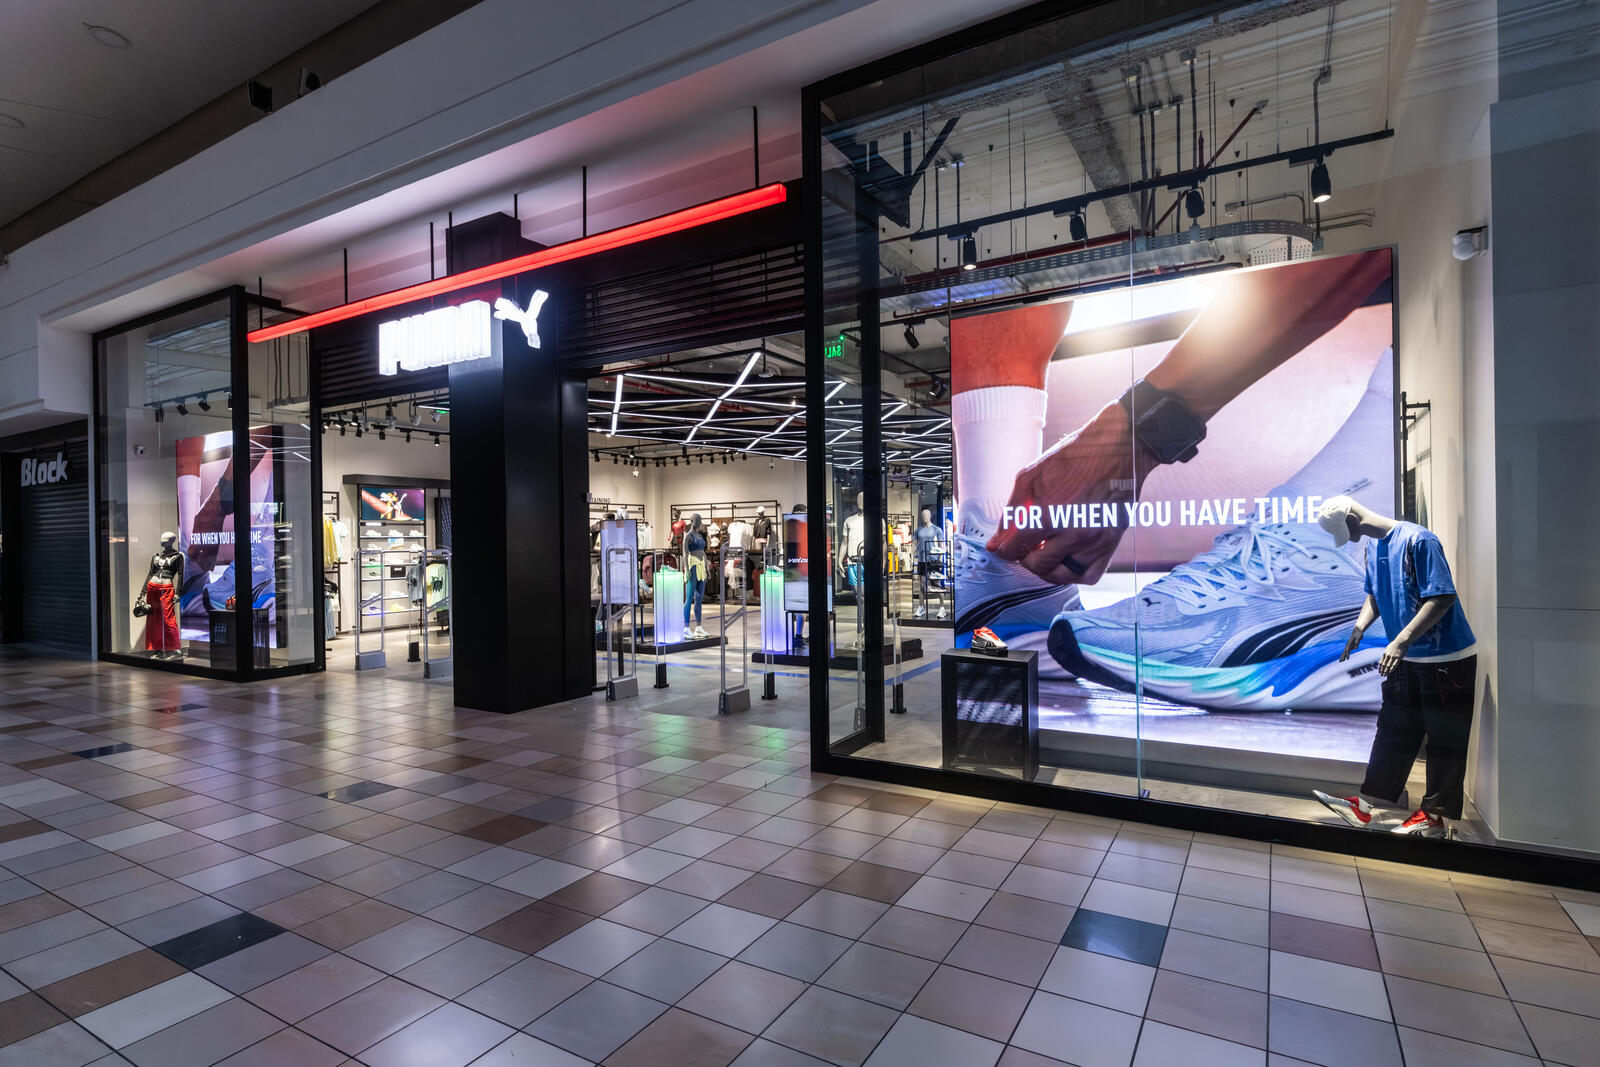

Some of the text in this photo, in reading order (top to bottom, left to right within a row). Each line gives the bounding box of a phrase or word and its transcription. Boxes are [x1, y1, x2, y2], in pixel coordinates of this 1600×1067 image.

[21, 452, 68, 487] Block
[1003, 495, 1322, 530] FOR WHEN YOU HAVE TIME
[190, 532, 201, 545] FOR
[202, 531, 219, 545] WHEN
[219, 531, 230, 545] YOU
[251, 530, 262, 544] IME
